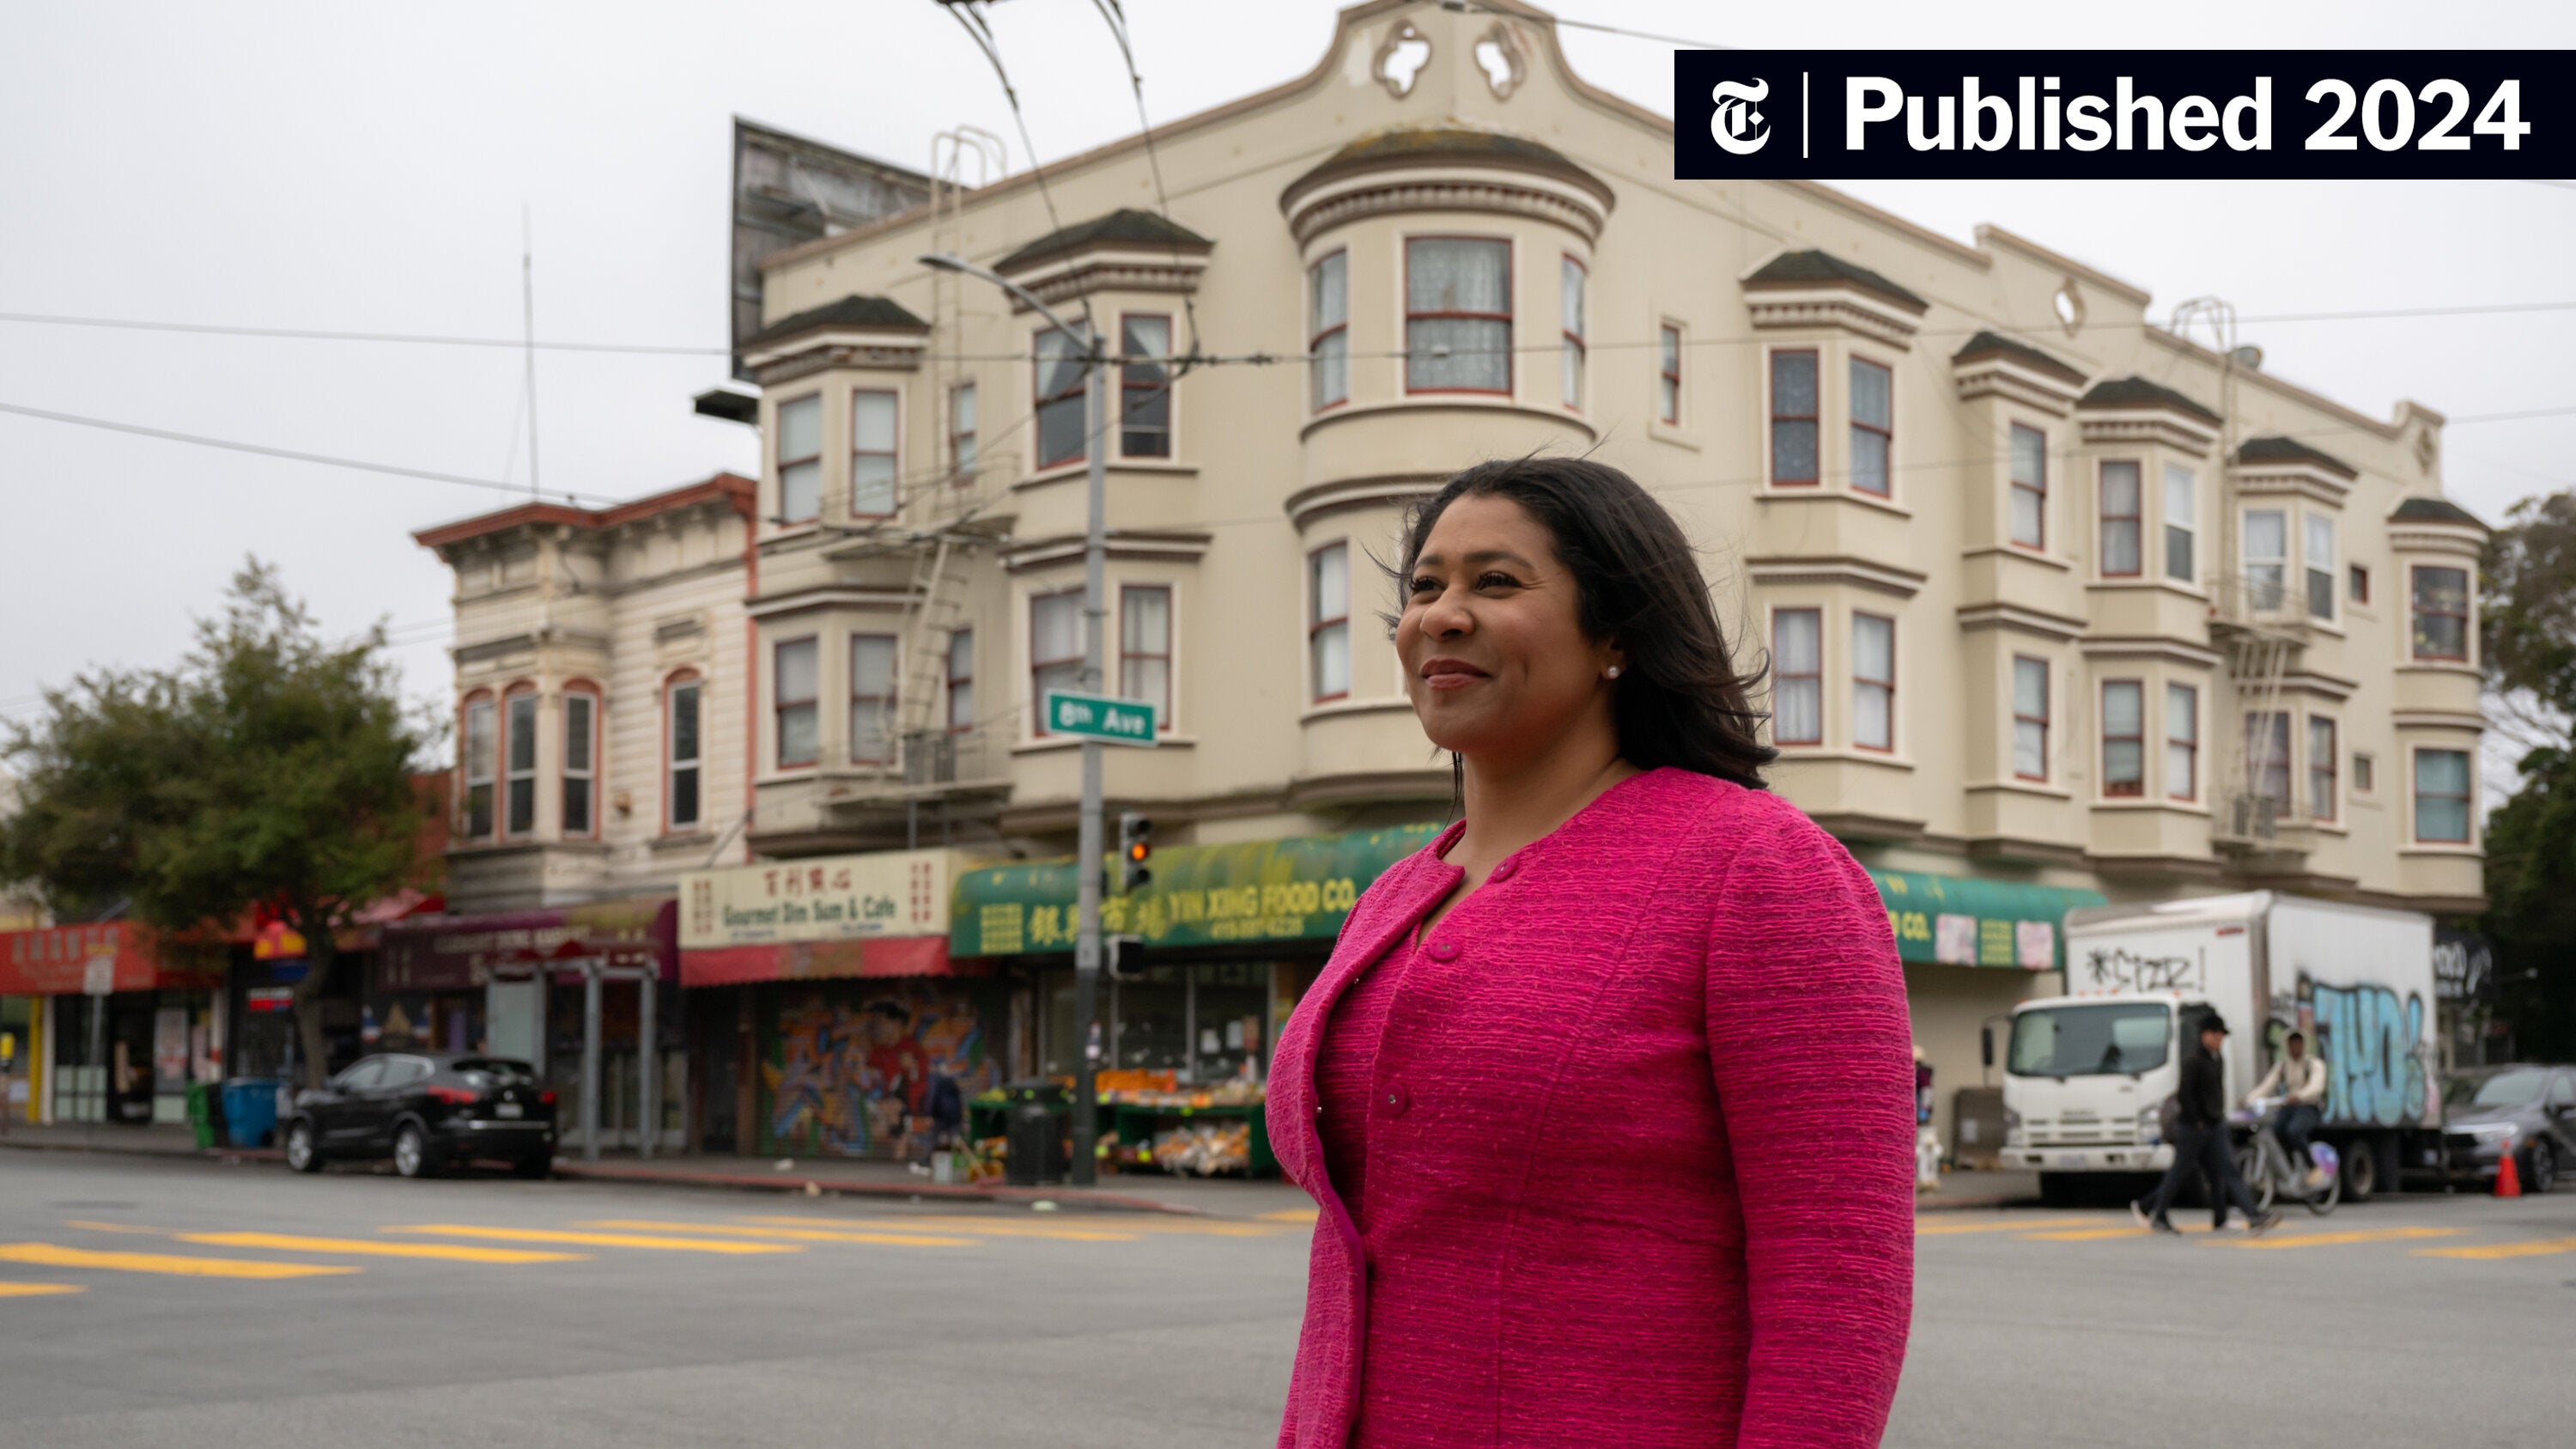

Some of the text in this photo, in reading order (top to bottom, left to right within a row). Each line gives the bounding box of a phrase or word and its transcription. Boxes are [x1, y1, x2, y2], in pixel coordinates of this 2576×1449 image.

[1059, 700, 1146, 735] 8th Ave
[724, 904, 778, 928] Gourmet
[783, 900, 808, 923] Dim
[814, 898, 842, 921] Sum
[849, 894, 858, 919] &
[864, 893, 896, 918] Cafe
[1169, 892, 1204, 922] YIN
[1207, 886, 1259, 918] XING
[1261, 880, 1320, 916] FOOD
